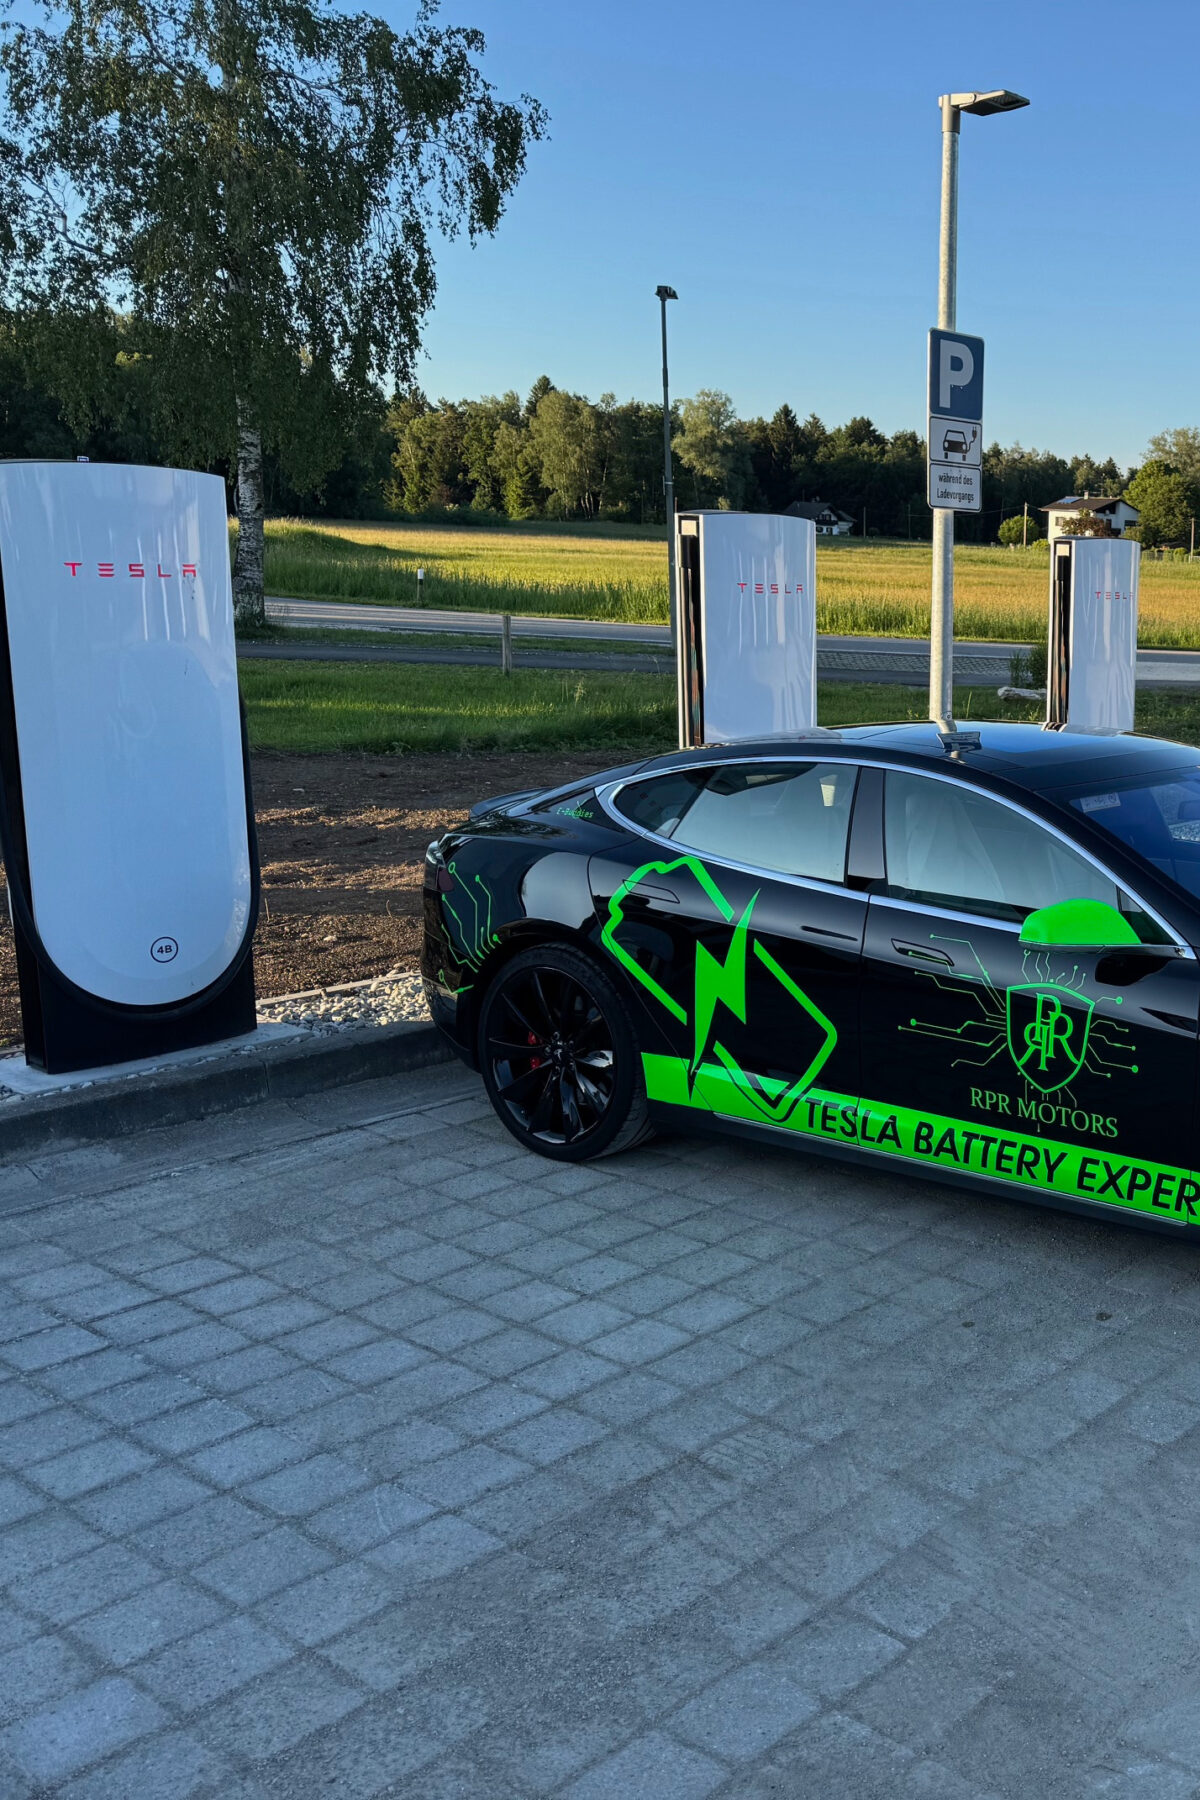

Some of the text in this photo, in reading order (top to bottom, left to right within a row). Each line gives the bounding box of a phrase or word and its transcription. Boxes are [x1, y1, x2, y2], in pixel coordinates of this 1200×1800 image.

[939, 339, 974, 408] P
[938, 472, 973, 486] während des
[936, 488, 974, 503] Ladevorgangs
[64, 562, 197, 578] TESLA
[737, 583, 803, 594] TESLA
[157, 944, 173, 954] 4B
[969, 1087, 1119, 1139] RPR MOTORS
[804, 1097, 903, 1149] TESLA
[914, 1121, 1068, 1183] BATTERY
